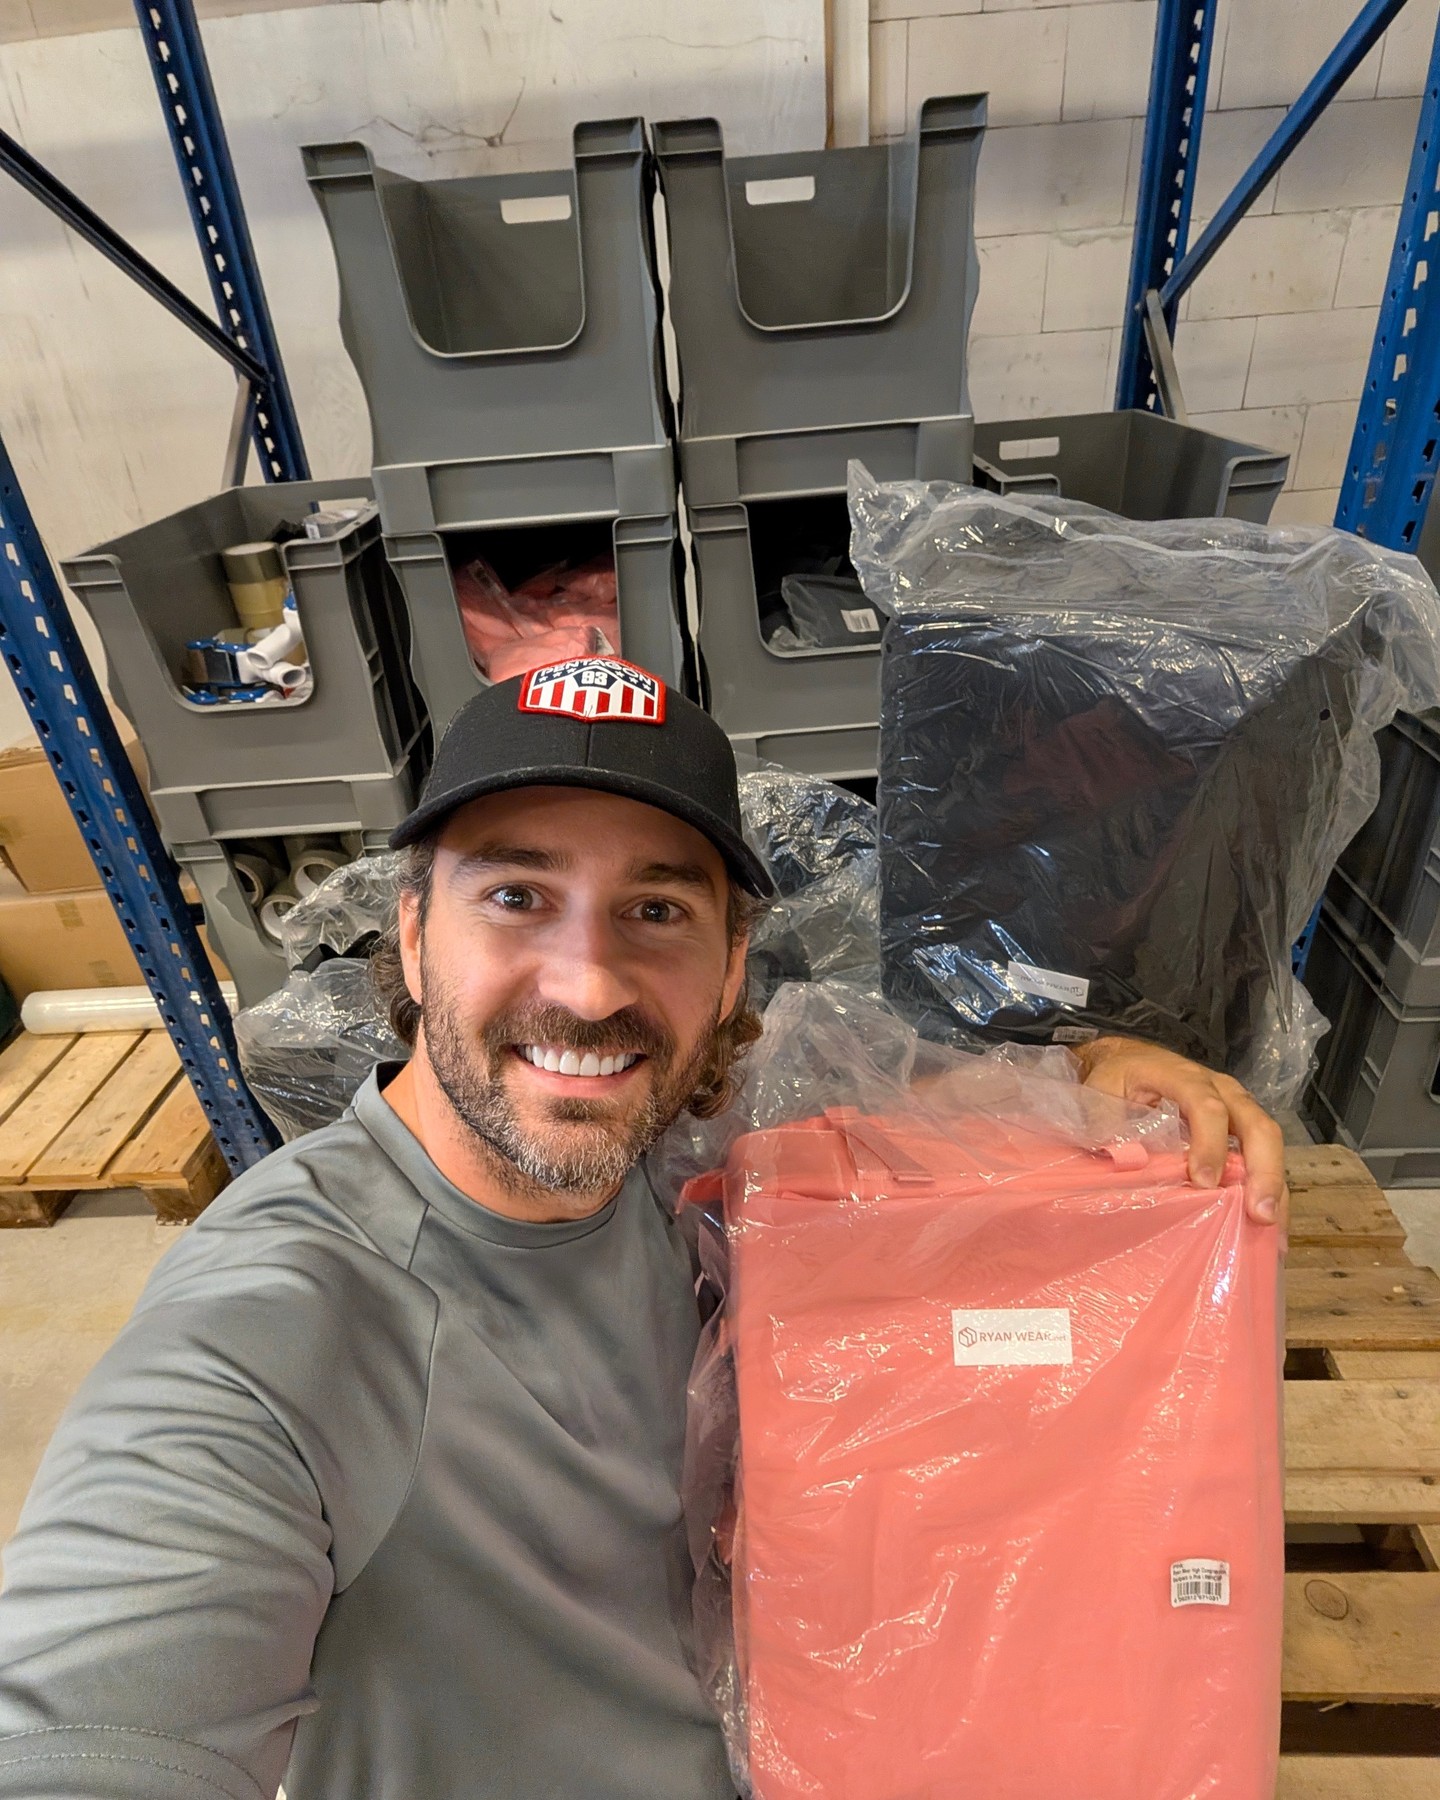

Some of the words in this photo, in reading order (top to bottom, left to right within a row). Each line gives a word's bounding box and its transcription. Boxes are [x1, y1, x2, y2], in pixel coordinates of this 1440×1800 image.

[540, 658, 651, 683] PENTAGON
[581, 671, 608, 686] 93
[979, 1331, 1012, 1342] RYAN
